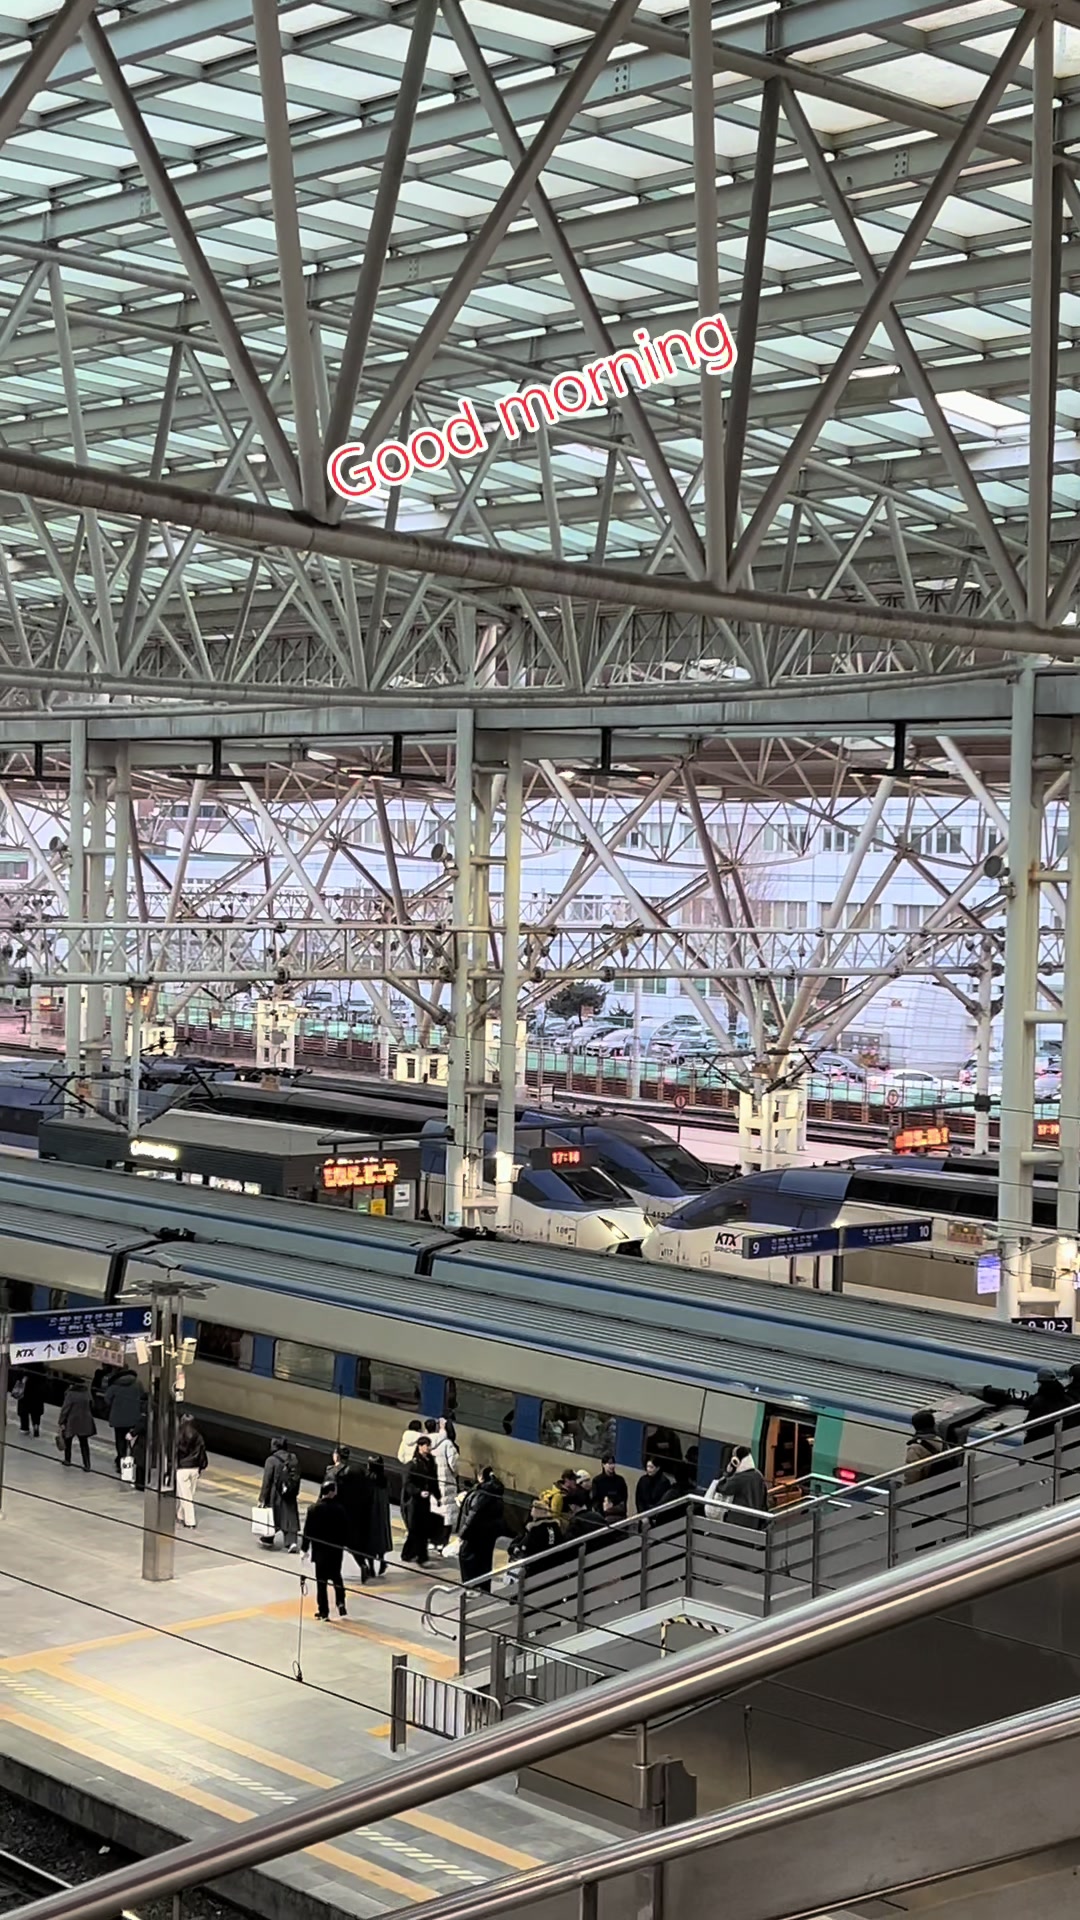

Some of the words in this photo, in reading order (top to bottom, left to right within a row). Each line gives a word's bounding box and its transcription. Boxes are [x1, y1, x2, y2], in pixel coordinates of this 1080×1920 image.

[919, 1225, 930, 1238] 10
[715, 1232, 744, 1247] KTX
[752, 1241, 760, 1255] 9
[143, 1311, 152, 1327] 8
[1042, 1320, 1056, 1331] 10
[15, 1347, 36, 1359] KTX
